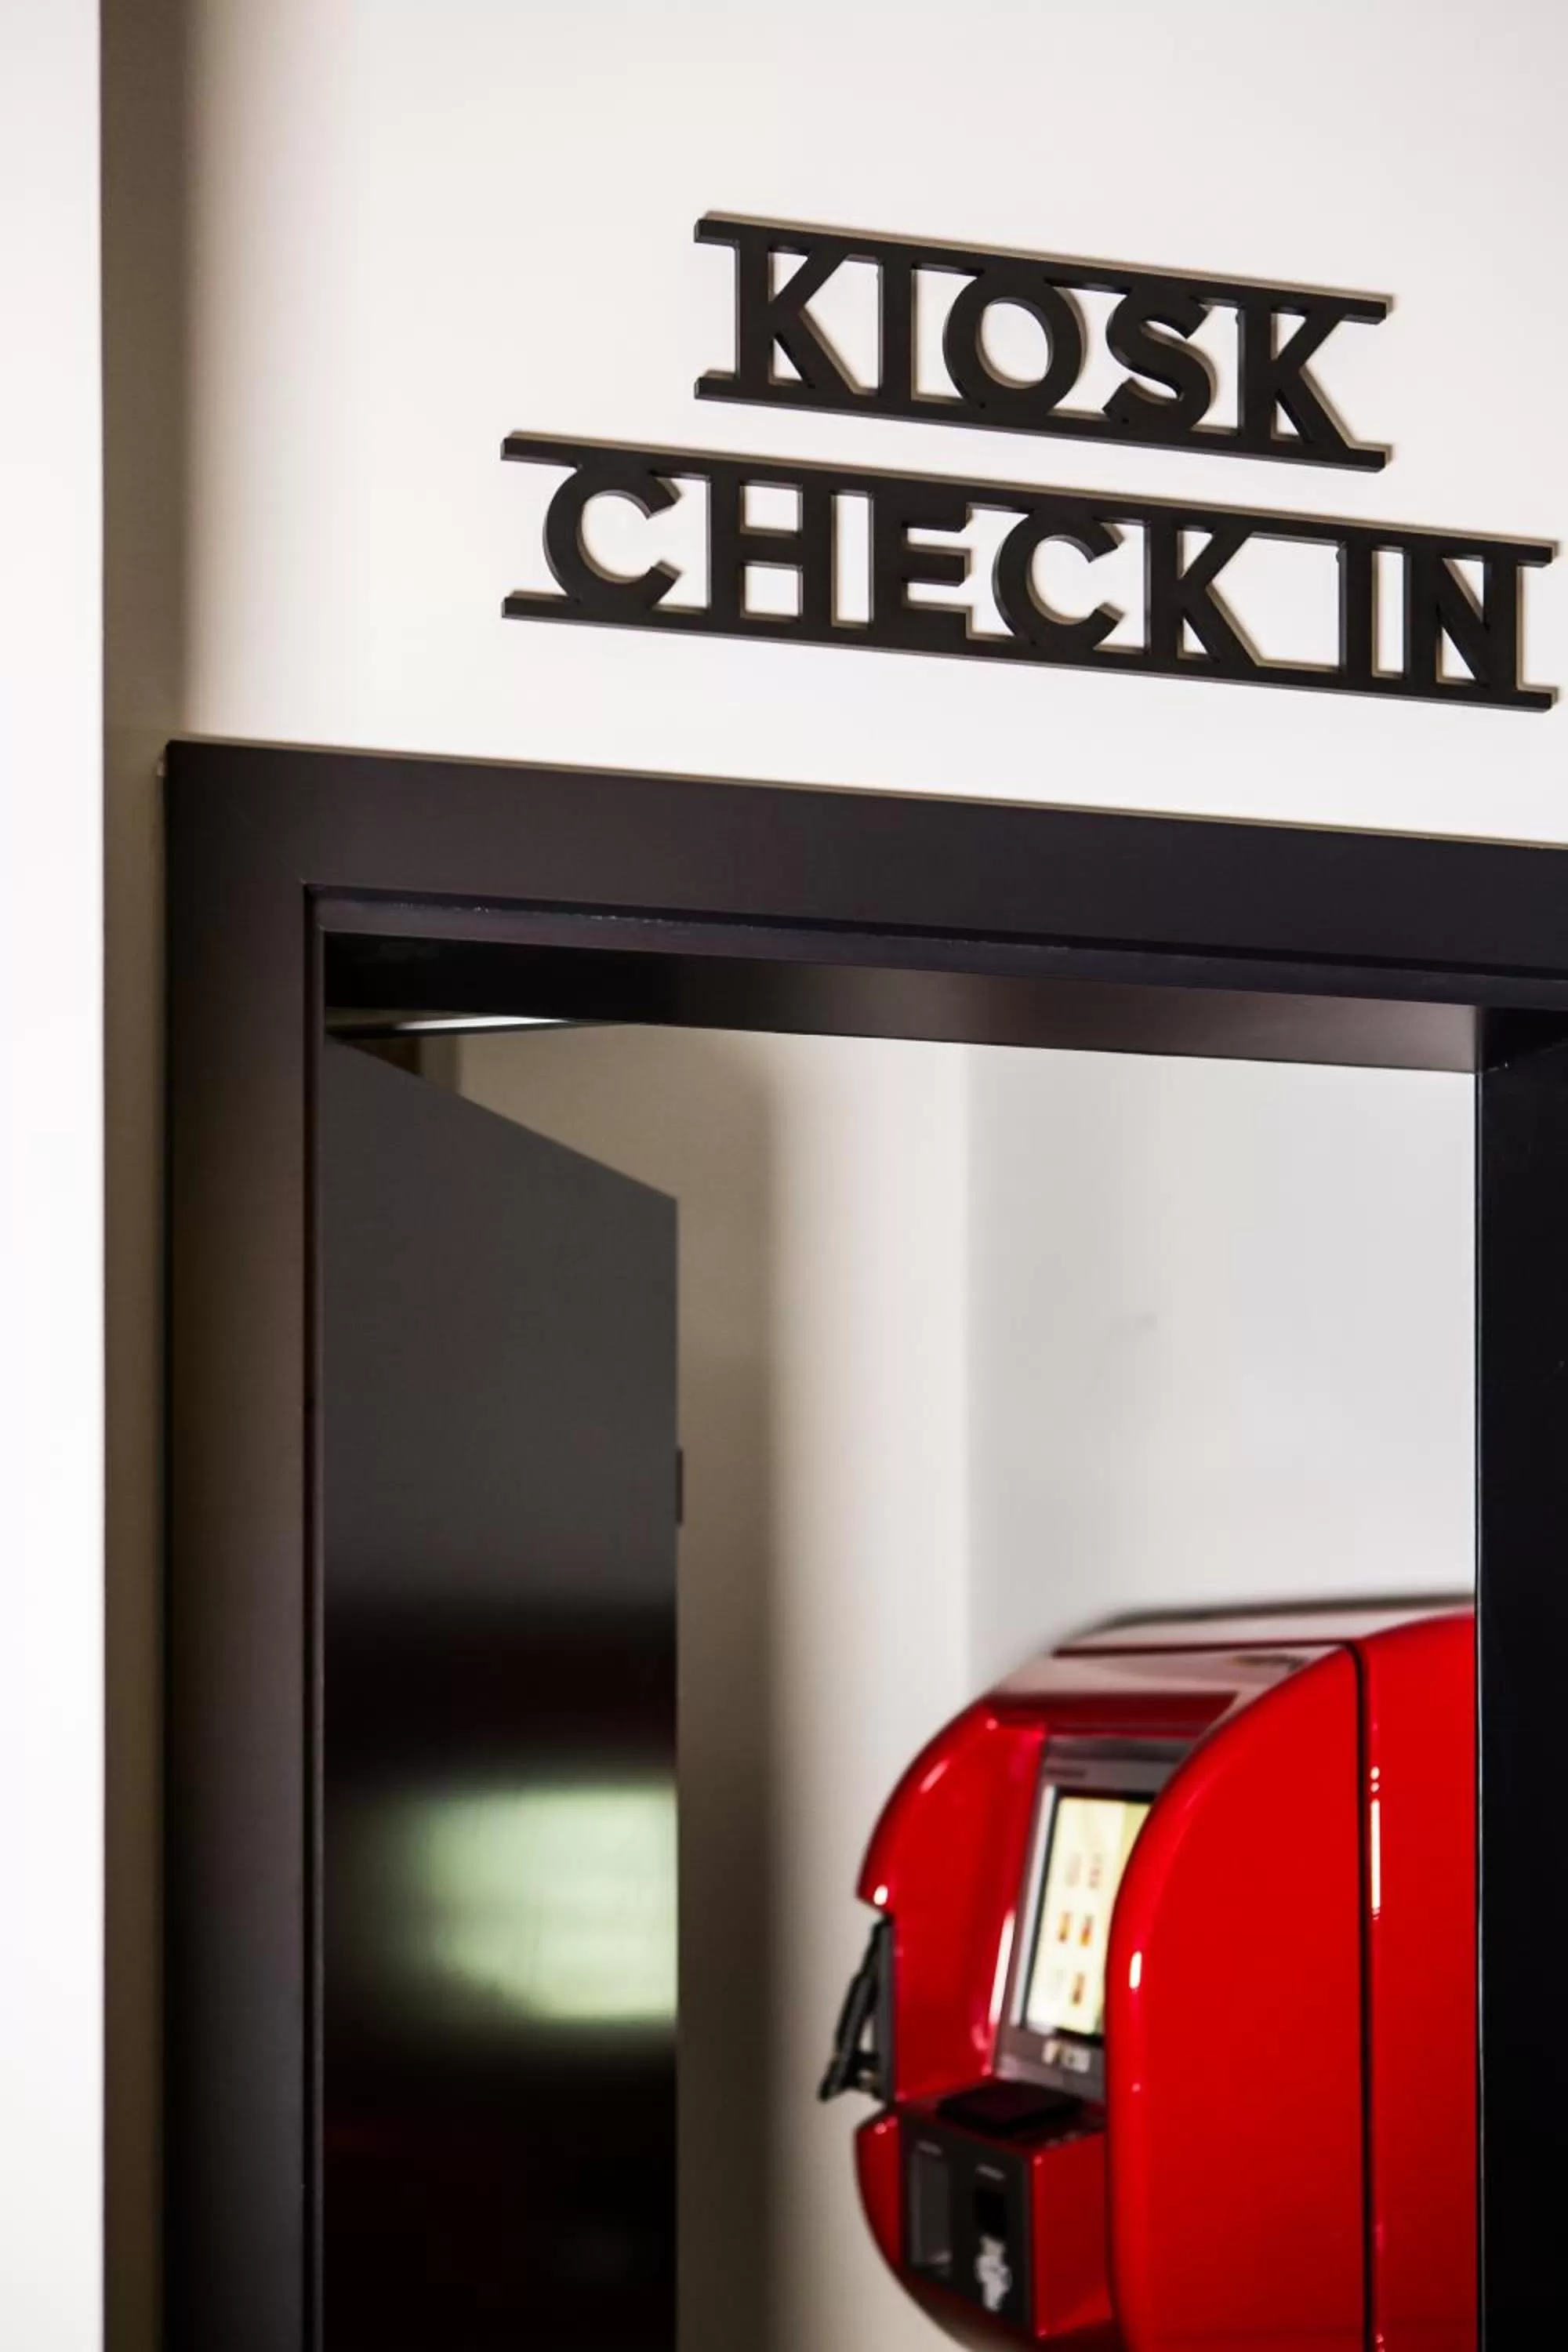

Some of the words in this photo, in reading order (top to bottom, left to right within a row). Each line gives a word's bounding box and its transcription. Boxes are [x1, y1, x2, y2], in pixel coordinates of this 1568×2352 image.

[695, 216, 1388, 472] KIOSK
[502, 436, 1269, 685] CHECK
[1333, 519, 1554, 712] IN
